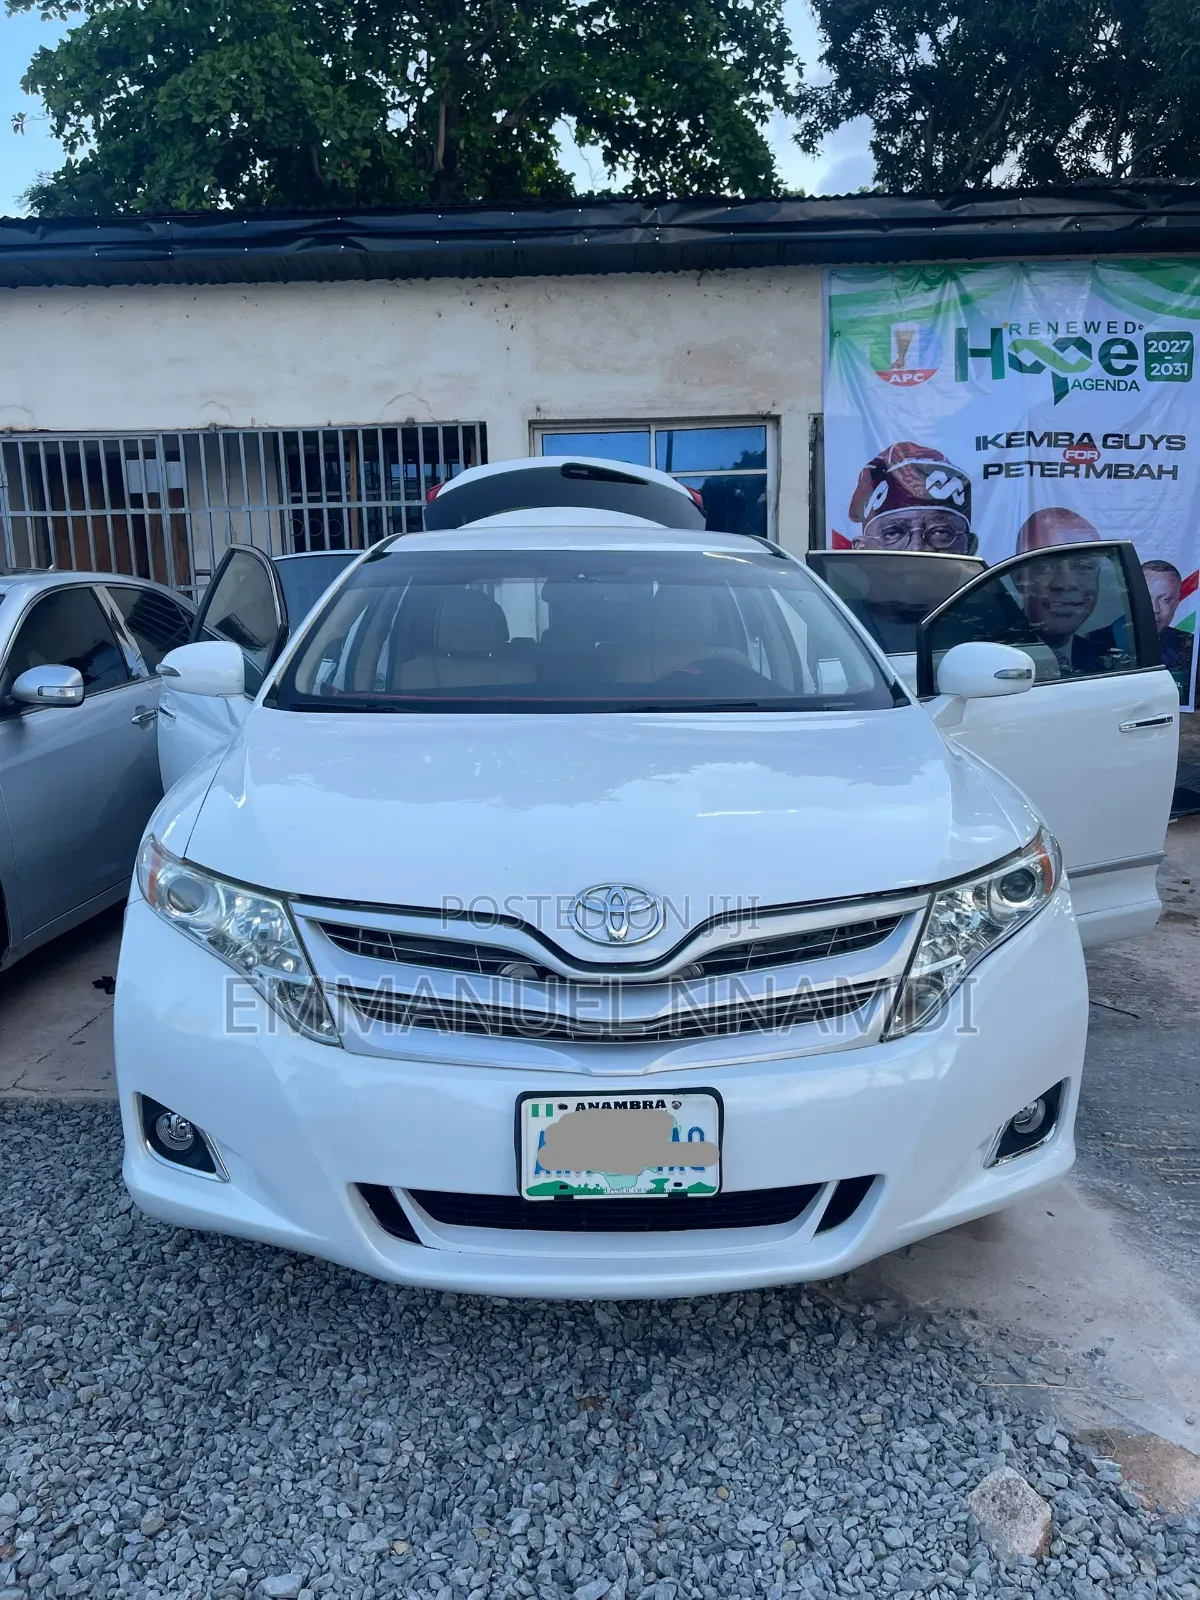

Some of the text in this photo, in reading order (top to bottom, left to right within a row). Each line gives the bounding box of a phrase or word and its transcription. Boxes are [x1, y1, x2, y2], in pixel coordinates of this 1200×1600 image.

[1008, 320, 1136, 336] RENEWED
[1147, 339, 1191, 353] 2027
[1150, 362, 1189, 376] 2031
[888, 373, 925, 383] APC
[1070, 378, 1141, 392] AGENDA
[975, 430, 1186, 451] IKEMBA GUYS
[1065, 450, 1099, 461] FOR
[983, 461, 1178, 480] PETER MBAH
[575, 1100, 667, 1111] ANAMBRA
